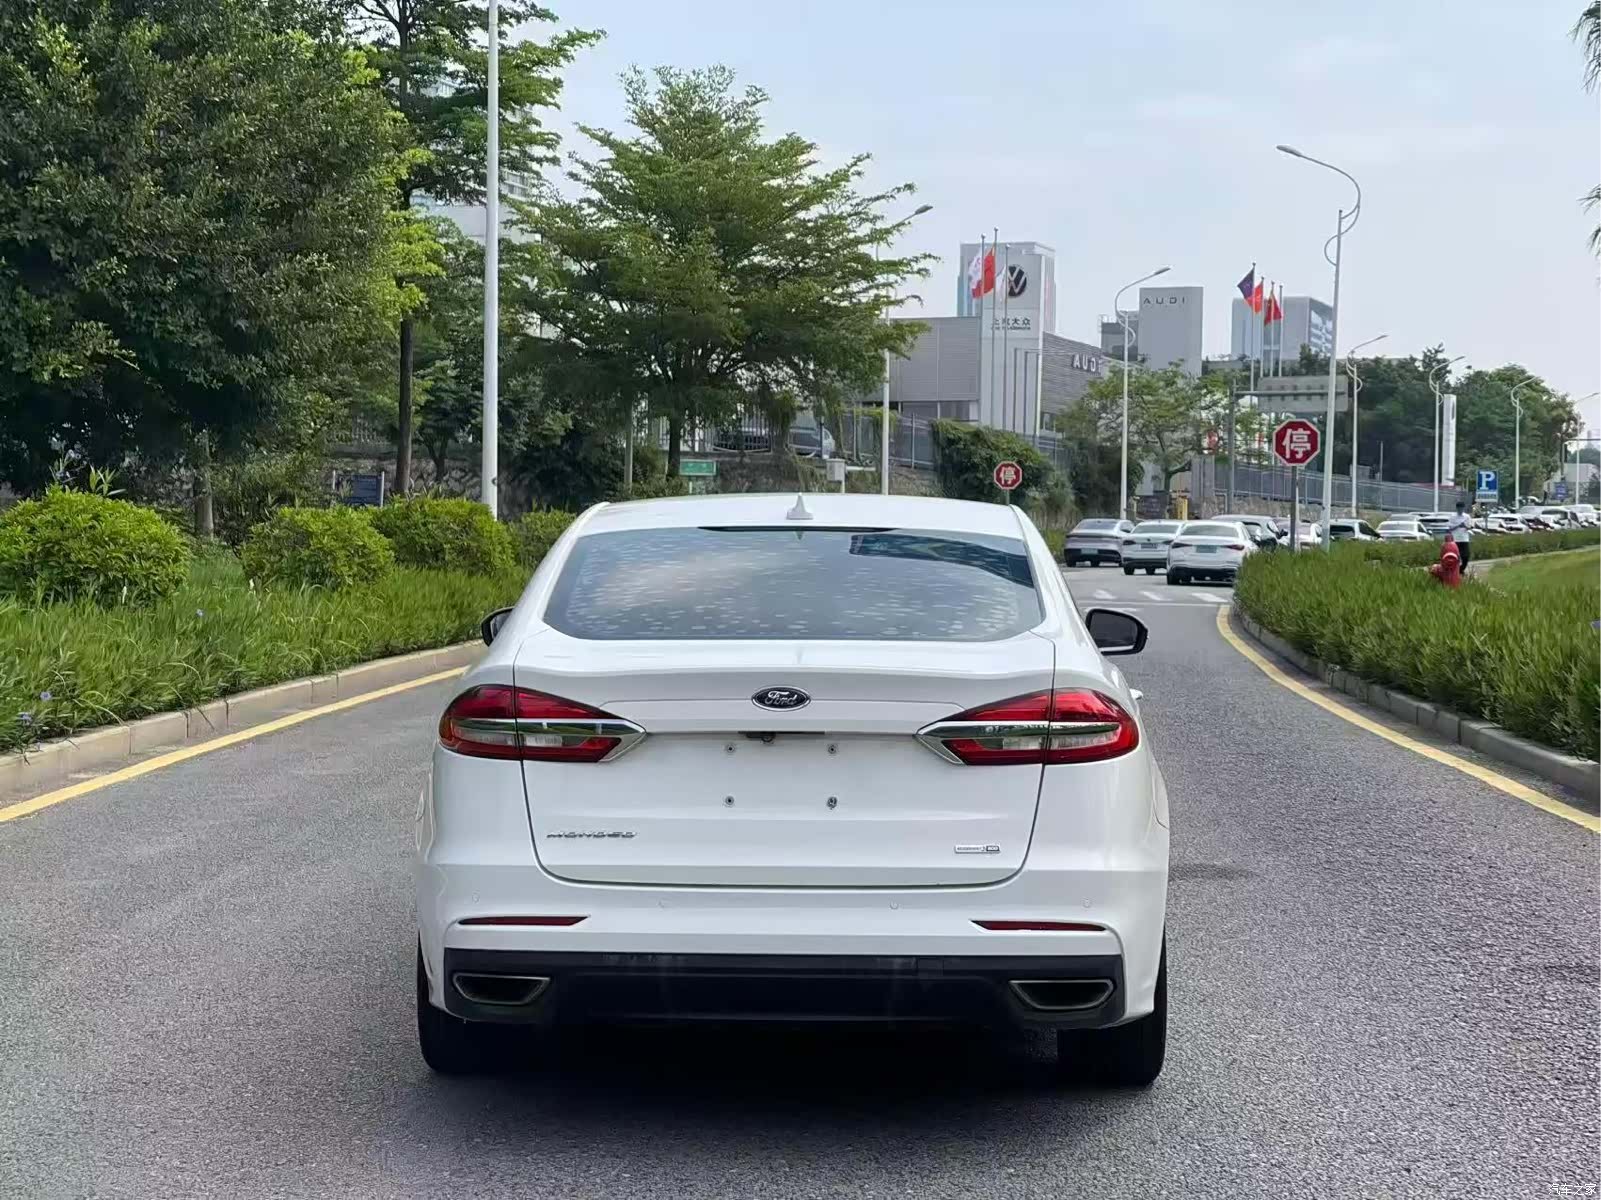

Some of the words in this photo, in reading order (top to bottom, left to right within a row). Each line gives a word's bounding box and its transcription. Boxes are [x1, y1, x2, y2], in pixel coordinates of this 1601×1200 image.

[1143, 296, 1185, 304] AUDI
[1281, 427, 1311, 459] 停
[999, 466, 1017, 485] 停
[1479, 471, 1496, 490] P
[764, 690, 798, 705] Ford
